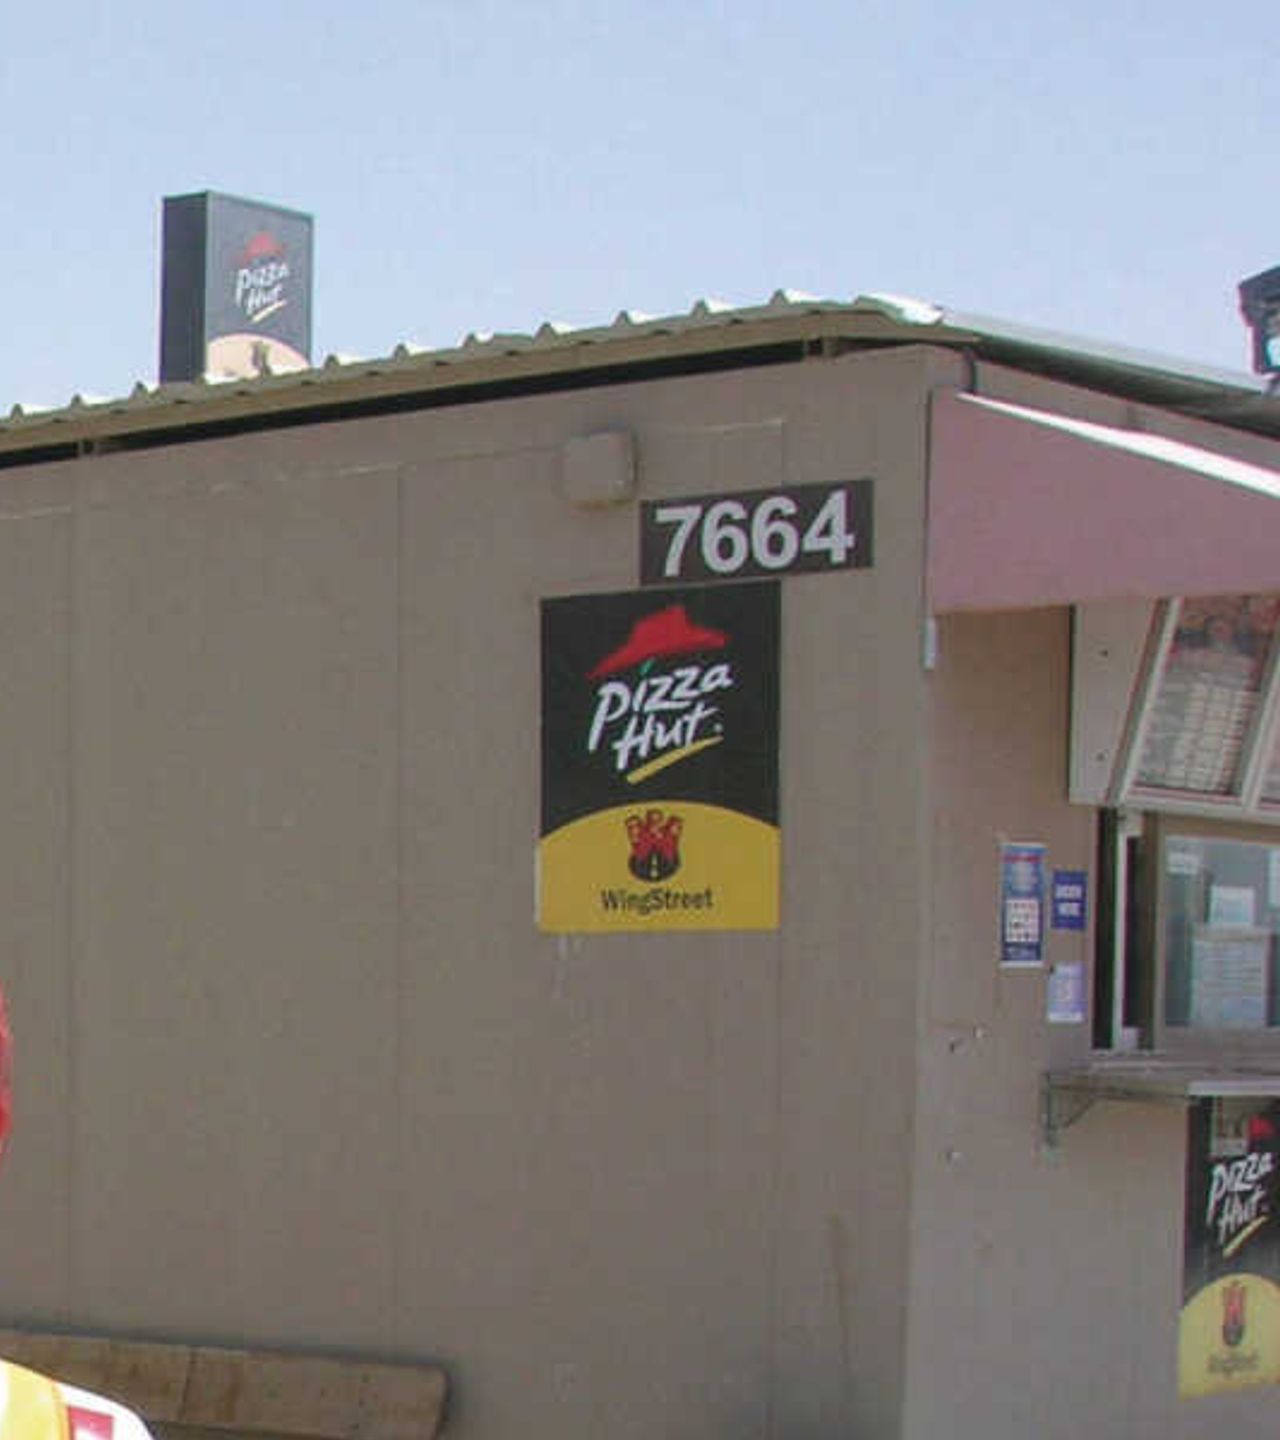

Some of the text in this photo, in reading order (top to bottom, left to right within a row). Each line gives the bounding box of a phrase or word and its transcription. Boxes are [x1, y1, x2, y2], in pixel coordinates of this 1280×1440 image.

[236, 262, 289, 307] Pizza
[246, 283, 283, 315] Hut
[655, 490, 855, 578] 7664
[589, 660, 735, 753] Pizza
[613, 703, 719, 771] Hut
[601, 888, 713, 915] WingStreet
[1206, 1152, 1274, 1229] Pizza
[1218, 1184, 1268, 1244] Hut
